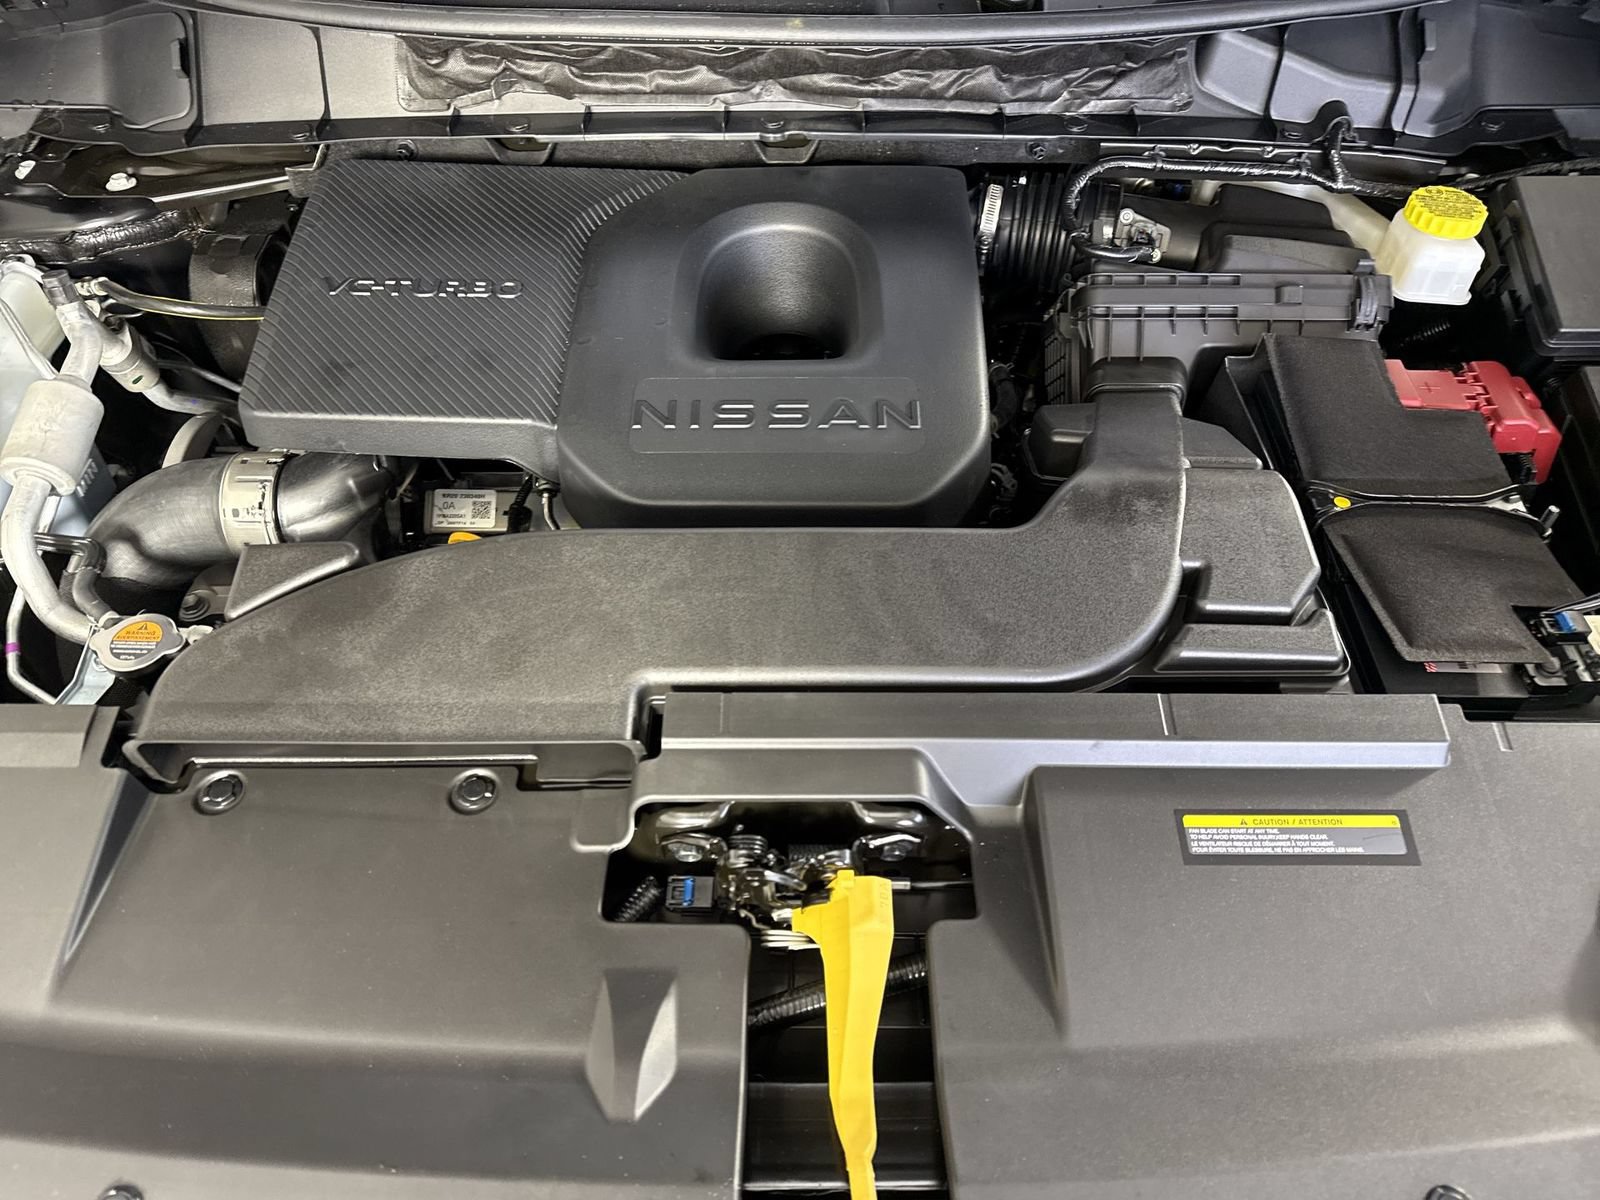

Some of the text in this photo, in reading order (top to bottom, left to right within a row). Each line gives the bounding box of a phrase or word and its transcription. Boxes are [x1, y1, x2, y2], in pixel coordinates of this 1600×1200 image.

[321, 276, 522, 299] VC-TURBO
[631, 398, 922, 429] NISSAN
[1252, 818, 1289, 826] CAUTION
[1298, 818, 1343, 826] ATTENTION
